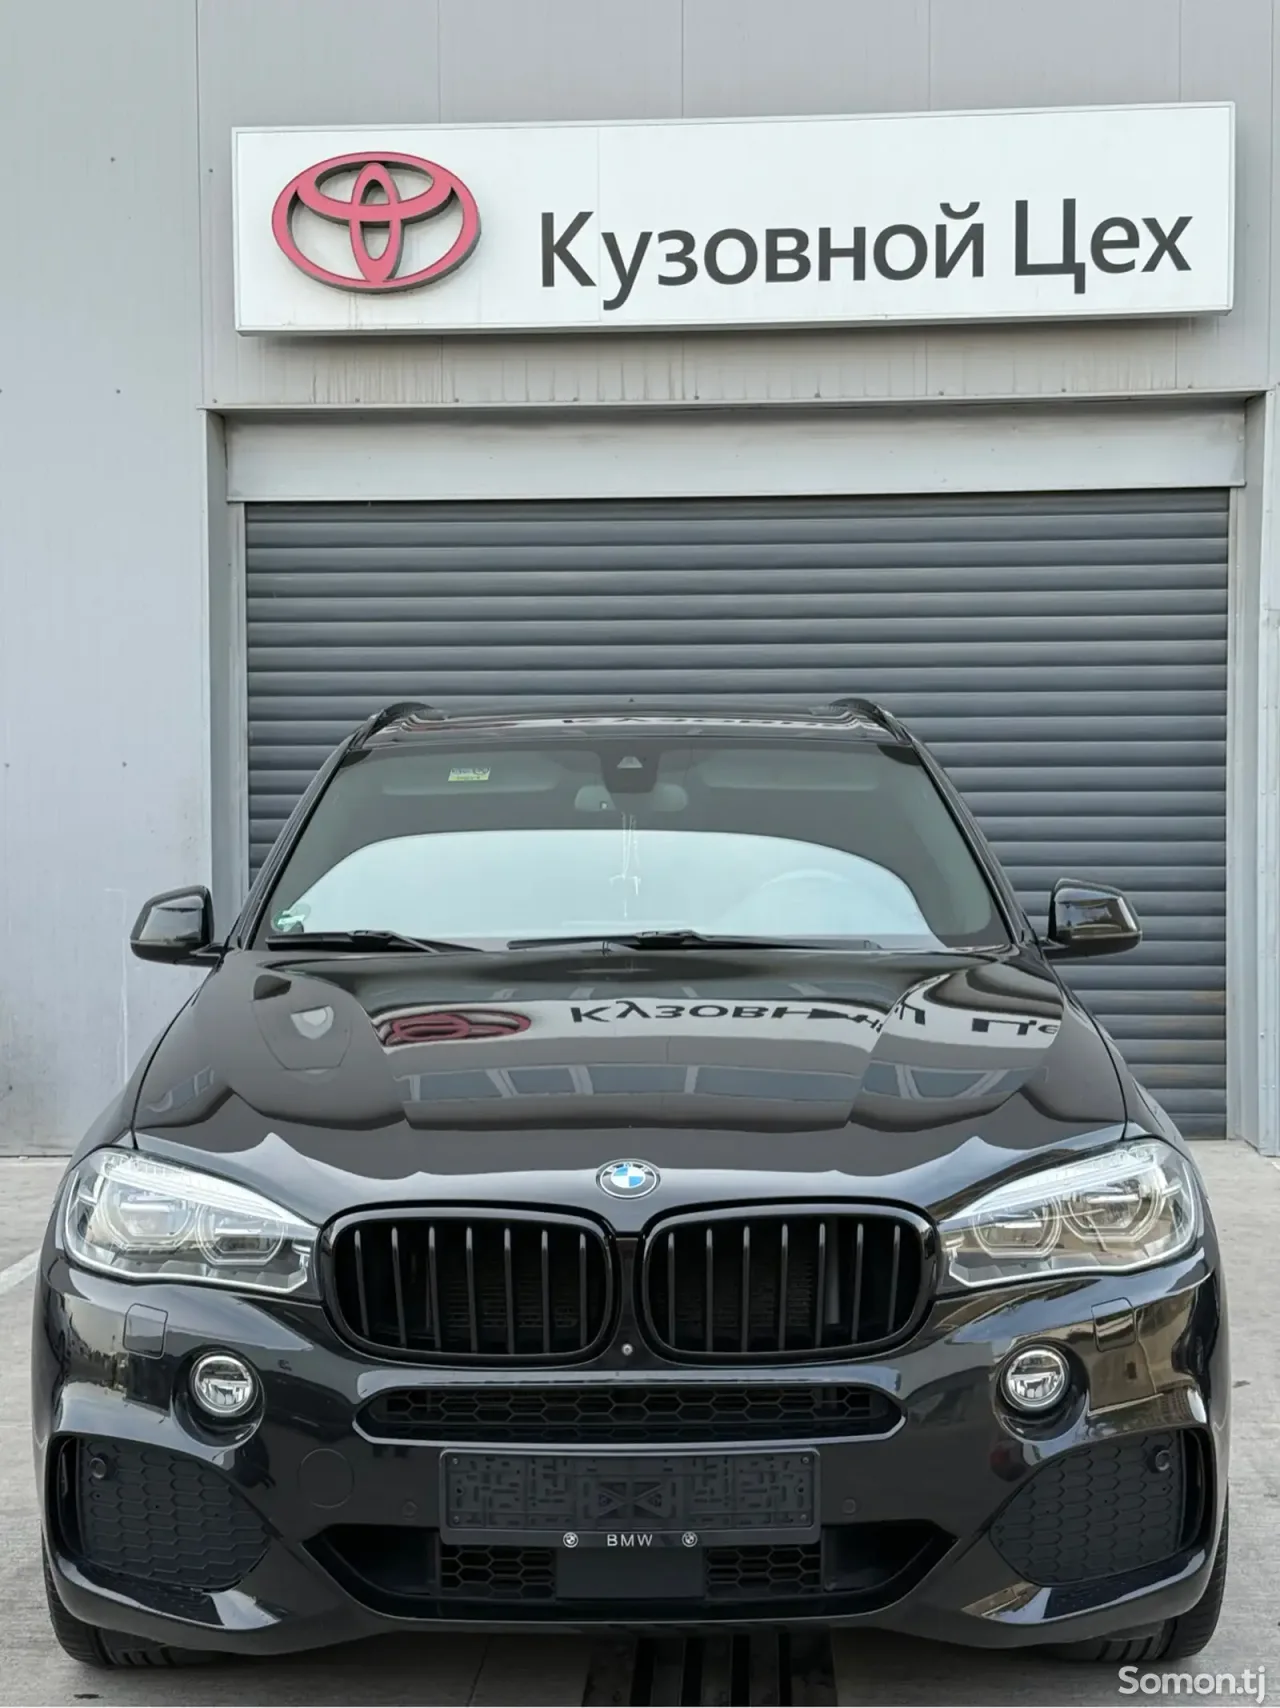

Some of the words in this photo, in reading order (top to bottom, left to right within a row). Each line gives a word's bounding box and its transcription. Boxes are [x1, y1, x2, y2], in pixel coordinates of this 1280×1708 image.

[541, 201, 984, 311] Кузовной
[1014, 198, 1193, 294] Цех
[606, 1533, 653, 1547] BMW
